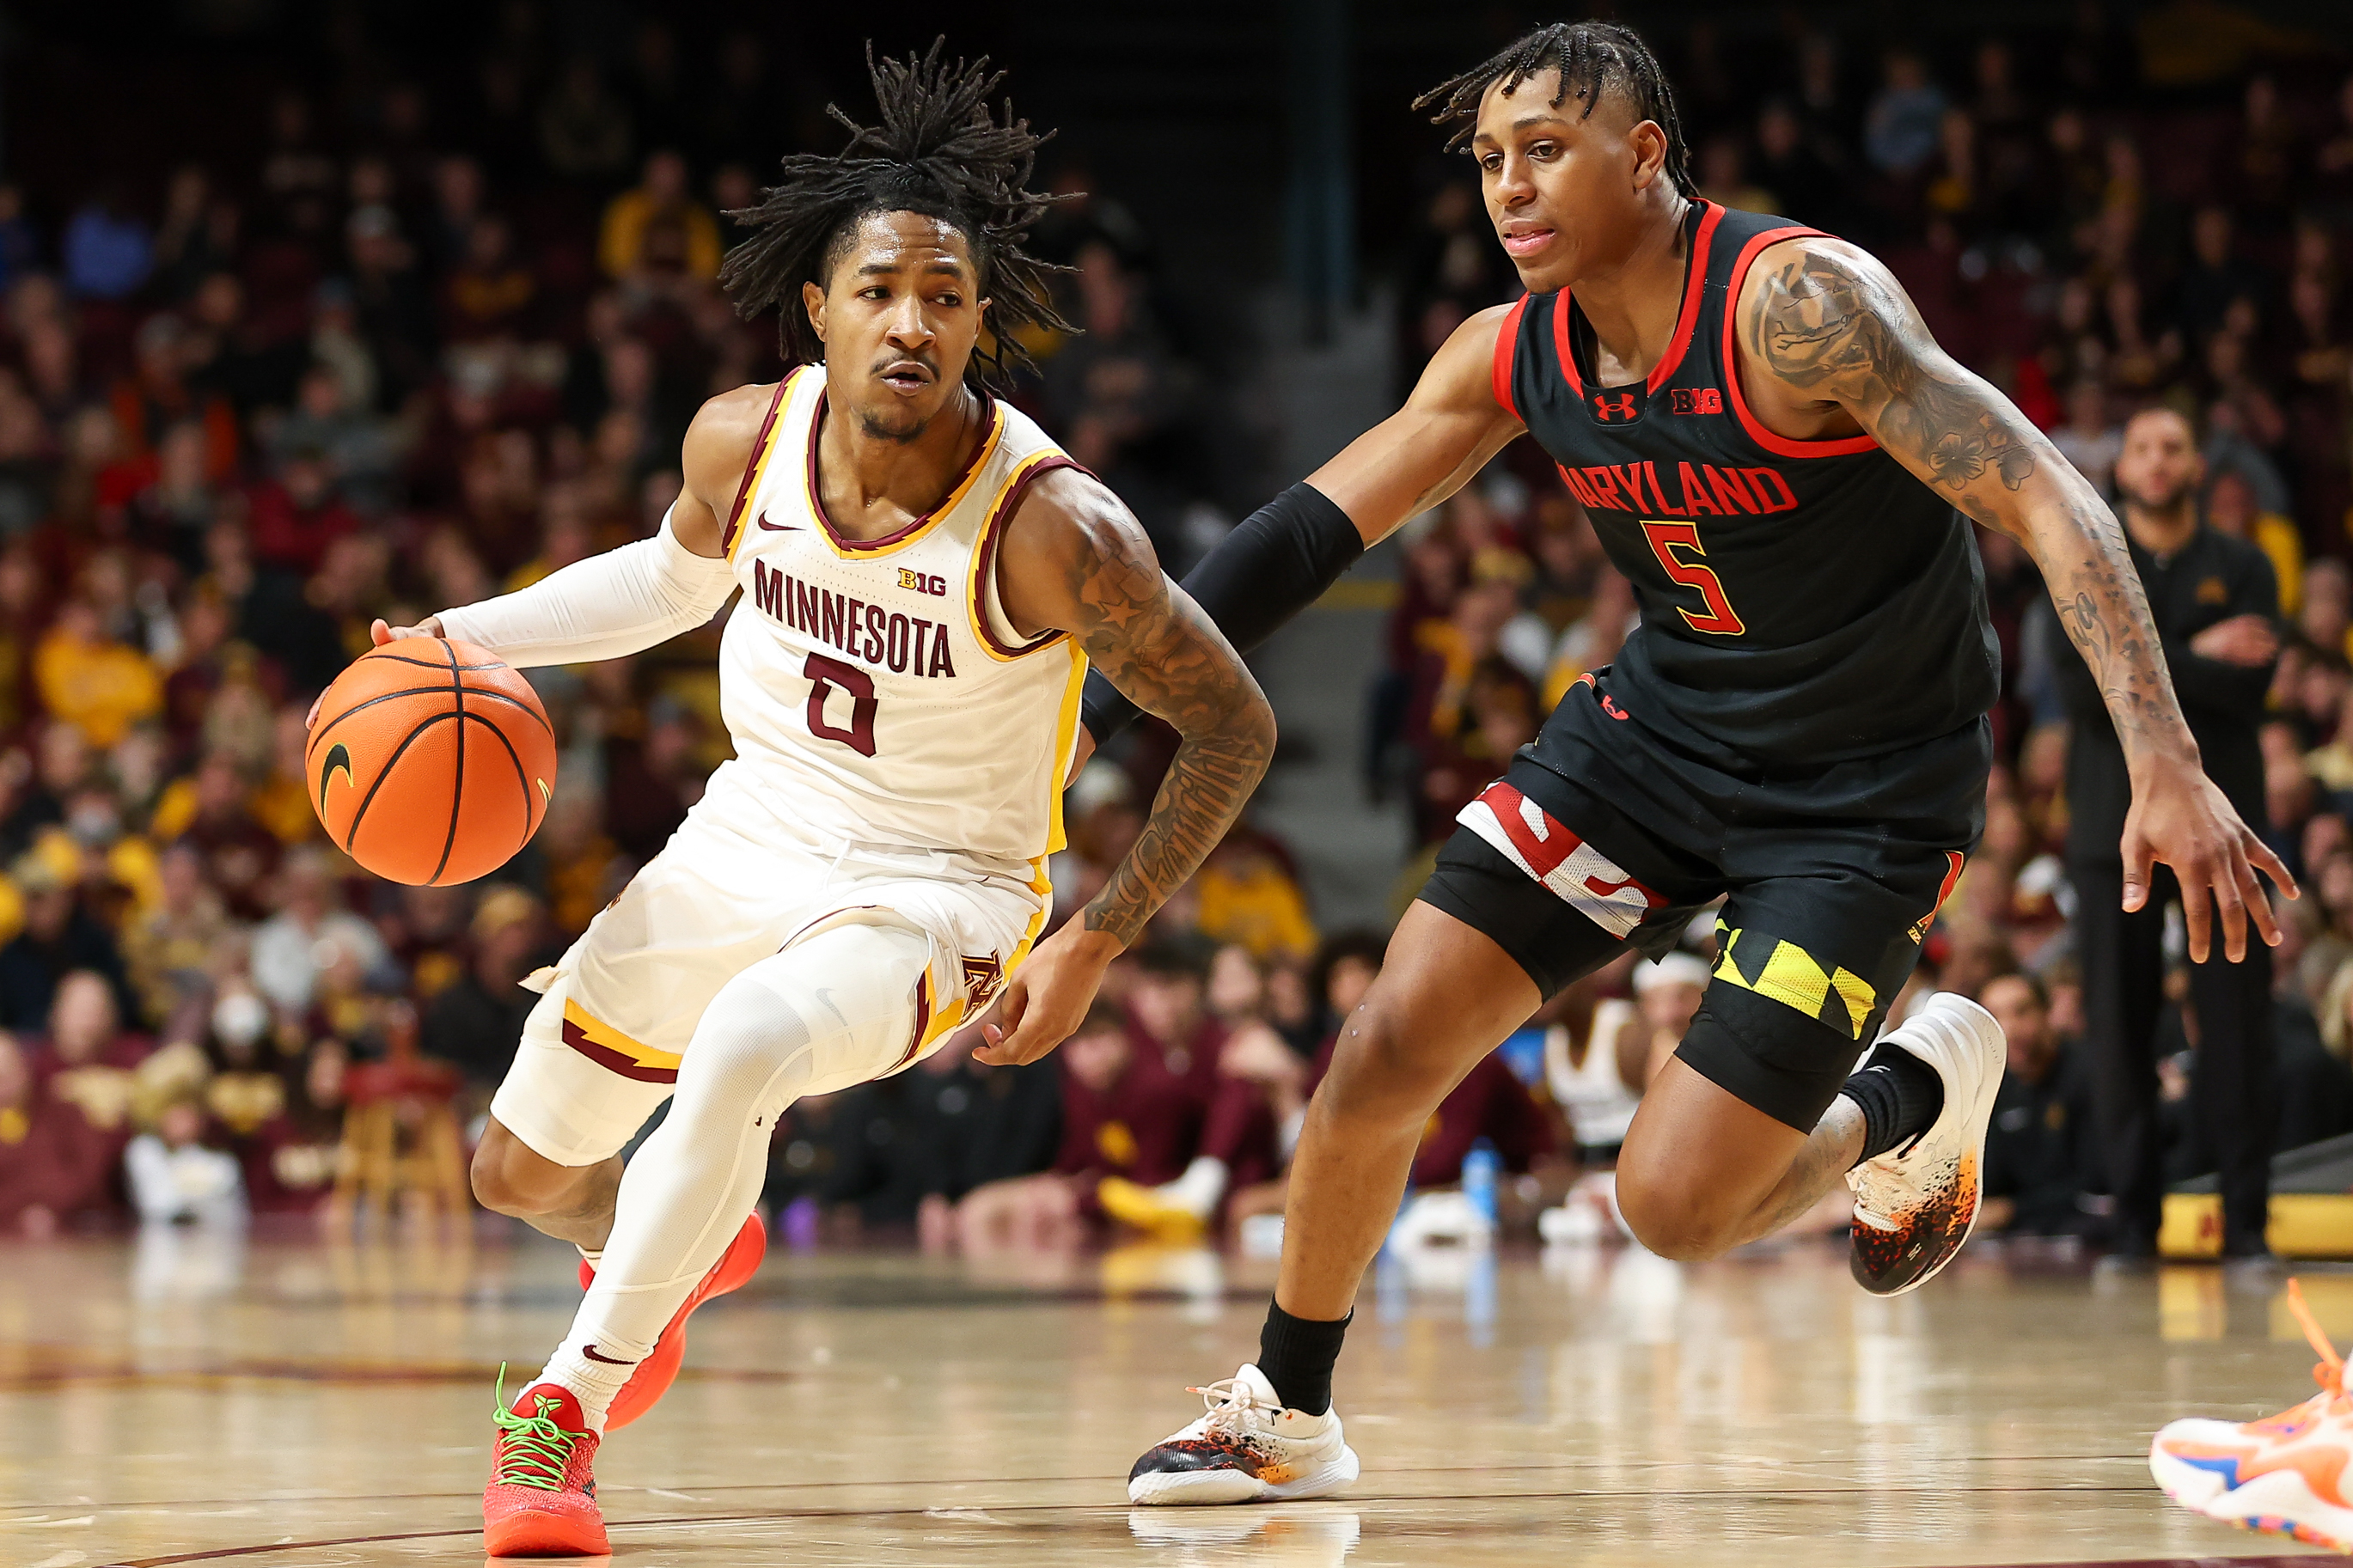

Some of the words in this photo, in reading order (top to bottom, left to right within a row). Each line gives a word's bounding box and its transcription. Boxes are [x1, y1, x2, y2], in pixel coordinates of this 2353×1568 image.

[755, 558, 956, 678] MINNESOTA
[1639, 520, 1746, 636] 5
[804, 651, 877, 759] 0
